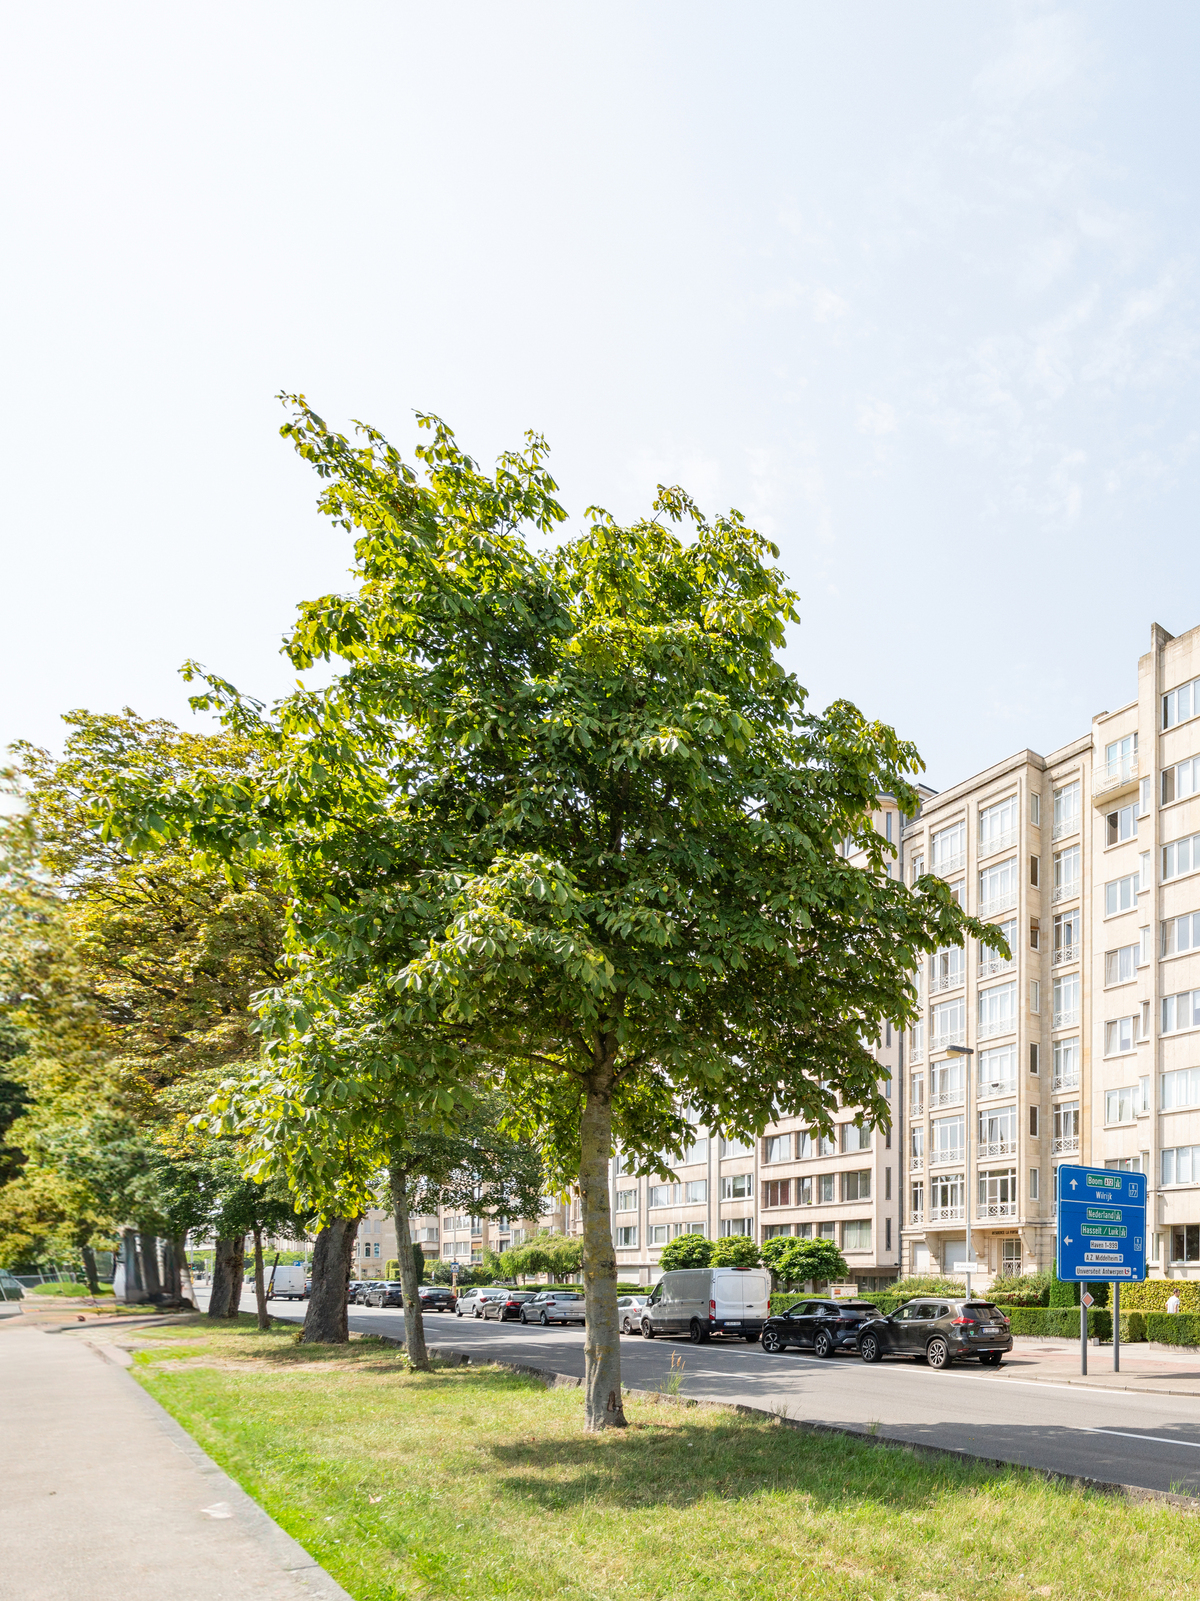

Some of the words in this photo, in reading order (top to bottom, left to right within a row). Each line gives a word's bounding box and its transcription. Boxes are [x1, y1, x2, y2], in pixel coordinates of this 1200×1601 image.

[1088, 1176, 1103, 1185] Boom
[1096, 1191, 1112, 1202] Wilrijk
[1088, 1209, 1114, 1220] Nederland
[1082, 1226, 1102, 1234] Hasselt
[1108, 1227, 1119, 1235] Luik
